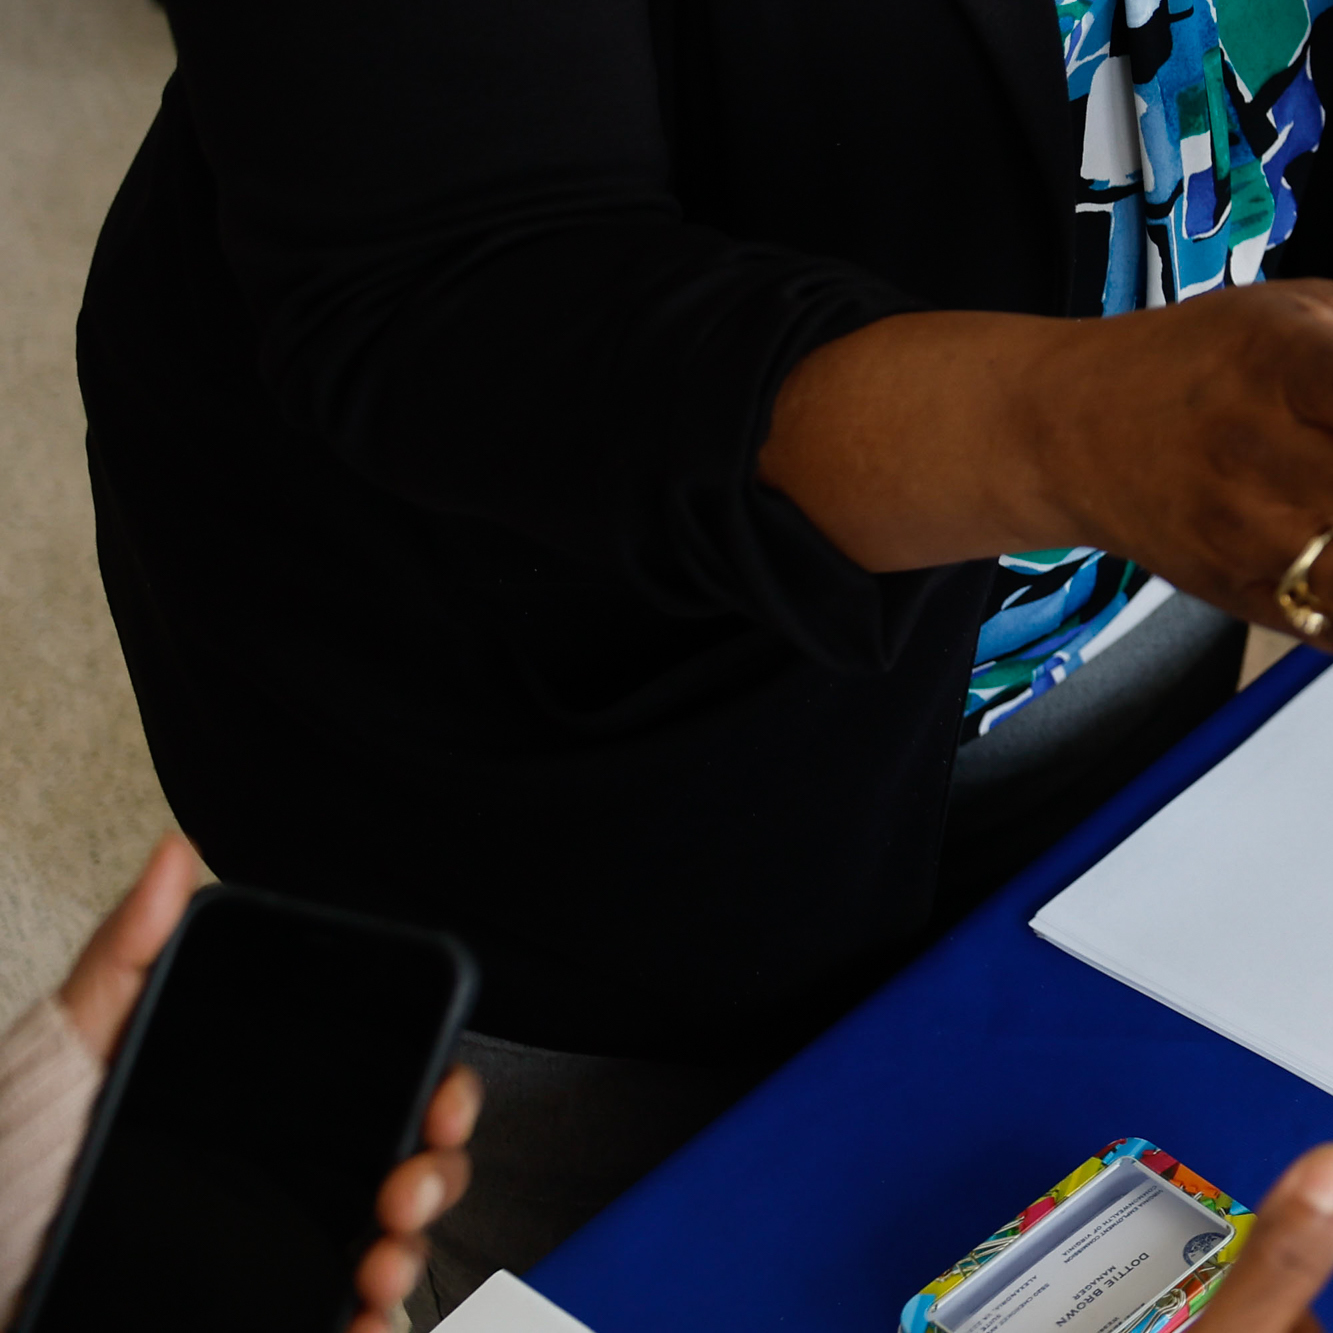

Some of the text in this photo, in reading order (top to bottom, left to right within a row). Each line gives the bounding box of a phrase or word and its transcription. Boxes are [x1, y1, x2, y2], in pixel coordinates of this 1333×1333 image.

[1061, 1184, 1157, 1256] COMMONWEALTH OF VIRGINIA
[1063, 1189, 1163, 1263] VIRGINIA EMPLOYMENT COMMISSION
[1052, 1251, 1150, 1327] DOTTIE BROWN
[1071, 1265, 1116, 1300] MANAGER
